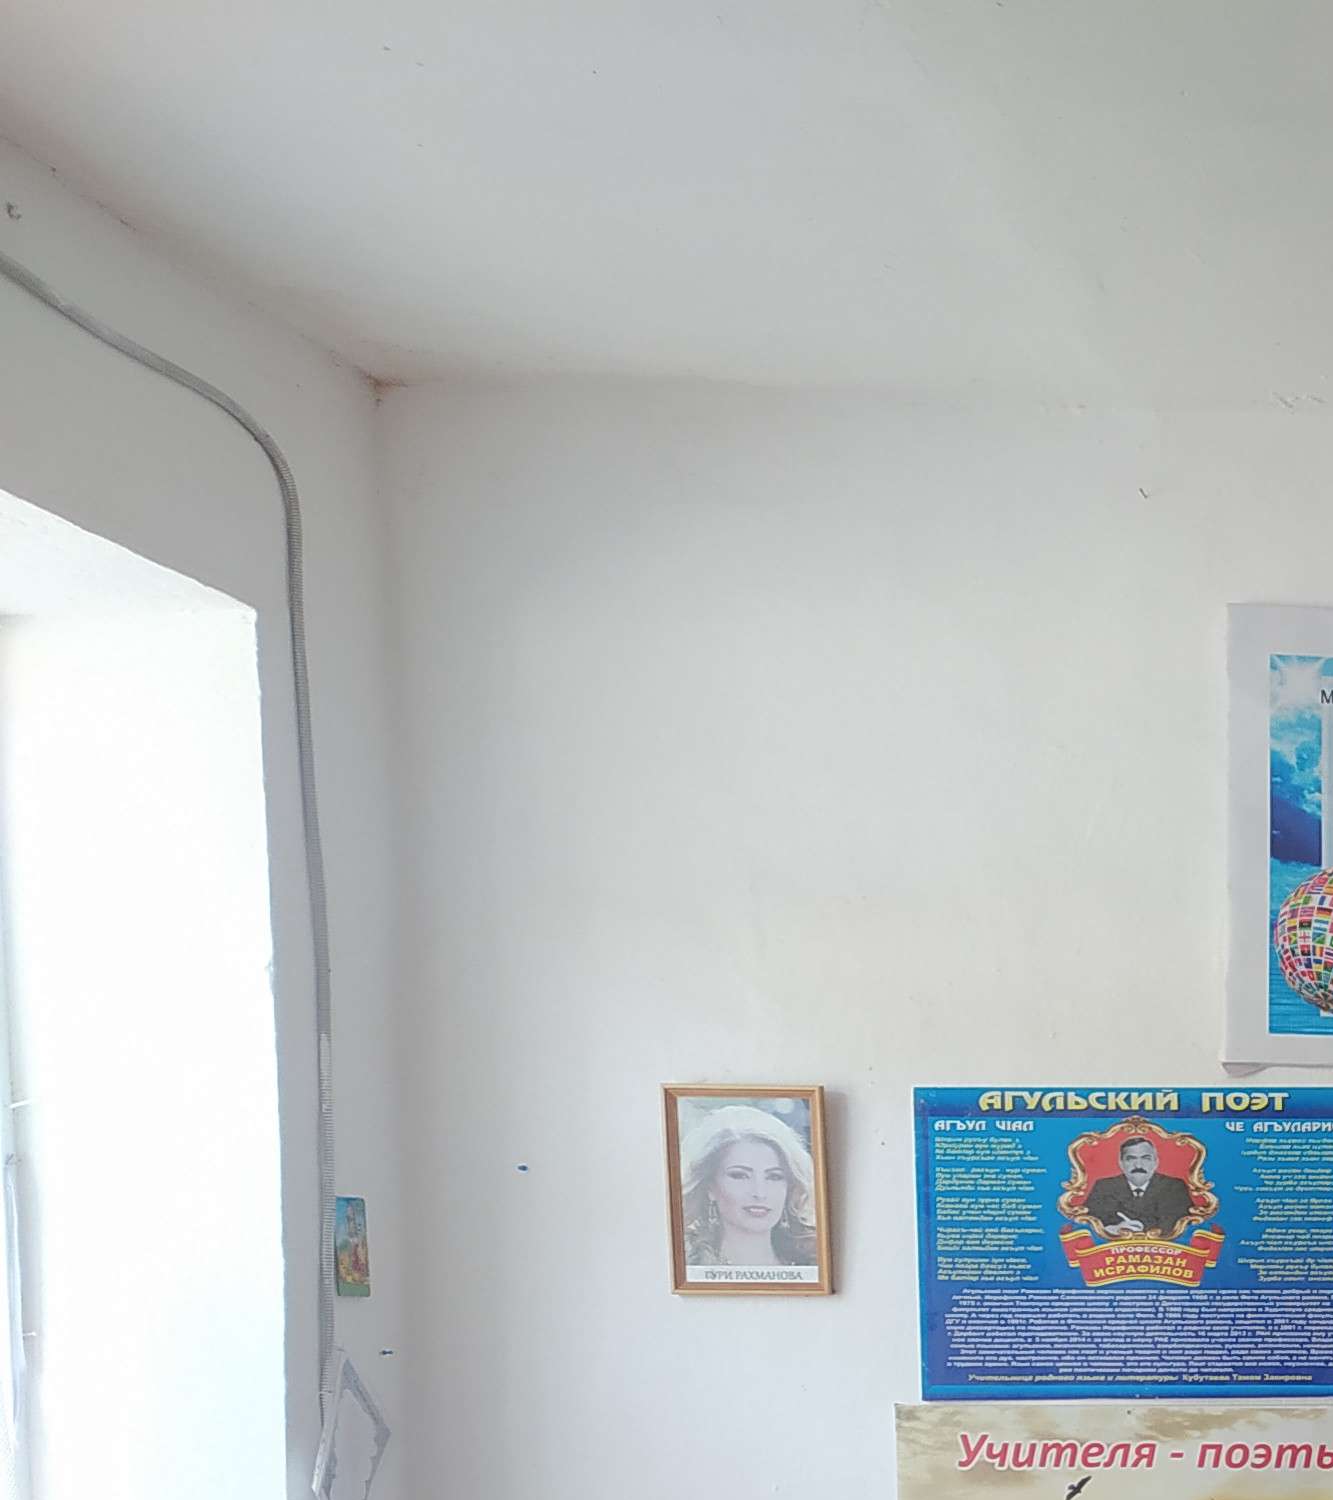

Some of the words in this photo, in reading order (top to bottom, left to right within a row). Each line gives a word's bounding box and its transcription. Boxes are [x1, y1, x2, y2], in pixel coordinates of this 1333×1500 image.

[978, 1089, 1180, 1113] АГУЛЬСКИЙ
[1201, 1092, 1290, 1113] ПОЭТ
[934, 1120, 986, 1131] АГЪУЛ
[1225, 1121, 1245, 1132] ЧЕ
[1111, 1246, 1182, 1256] ПРОФЕССОР
[1105, 1255, 1187, 1268] РАМАЗАН
[735, 1270, 803, 1281] РАХМАНОВА
[1093, 1265, 1194, 1279] ИСРАФИЛОВ
[958, 1433, 1156, 1470] Учителя
